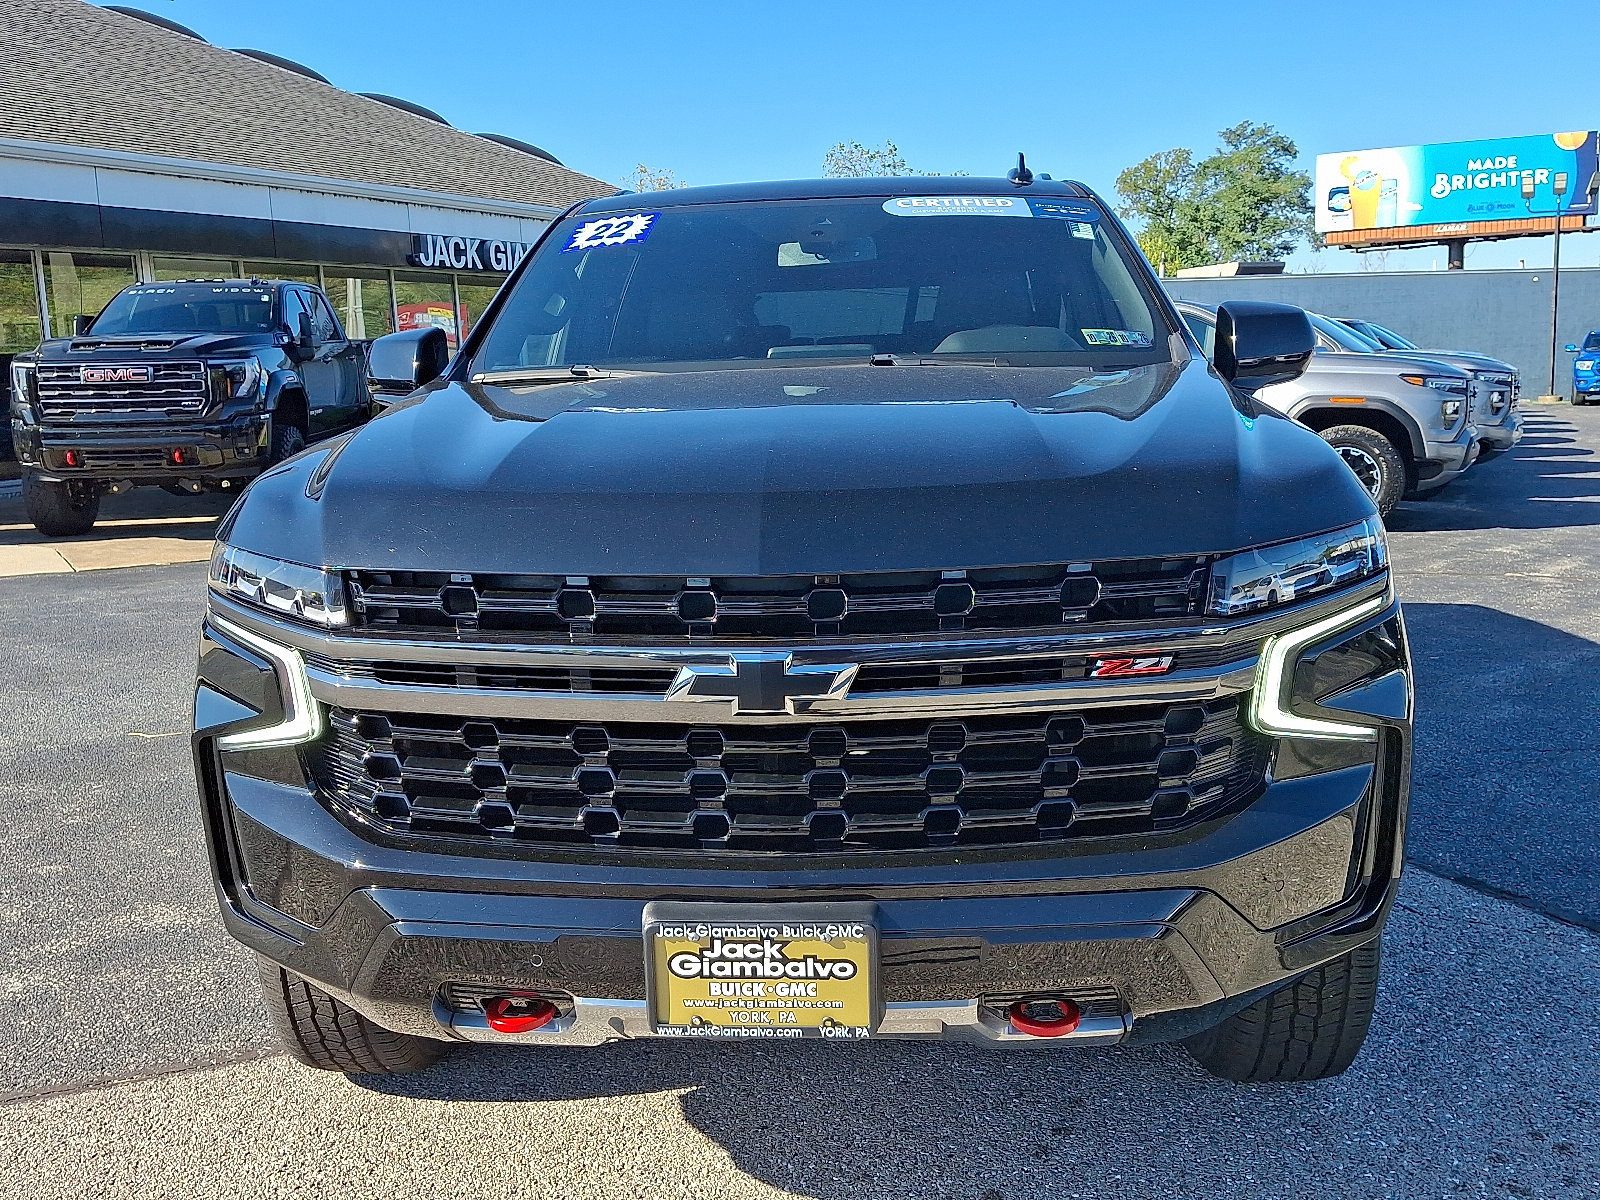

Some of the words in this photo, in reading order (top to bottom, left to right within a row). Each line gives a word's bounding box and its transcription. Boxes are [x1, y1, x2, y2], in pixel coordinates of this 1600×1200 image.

[1467, 155, 1518, 171] MADE
[896, 198, 1014, 208] CERTIFIED
[585, 220, 634, 242] 22
[419, 234, 484, 270] JACK
[489, 239, 532, 271] GIA
[1087, 333, 1098, 343] 10
[85, 368, 148, 382] GMC
[1090, 656, 1173, 678] Z71
[656, 924, 692, 938] Jack
[696, 924, 778, 938] Giambalvo
[783, 924, 822, 938] Buick
[826, 924, 864, 938] GMC
[702, 939, 783, 959] Jack
[669, 953, 856, 978] Giambalvo
[683, 999, 844, 1009] www.jackgiambalvo.com
[728, 1011, 775, 1025] YORK,
[778, 1011, 798, 1024] PA
[656, 1025, 803, 1038] www.JackGiambalvo.com
[819, 1026, 853, 1039] YORK,
[855, 1027, 870, 1038] PA
